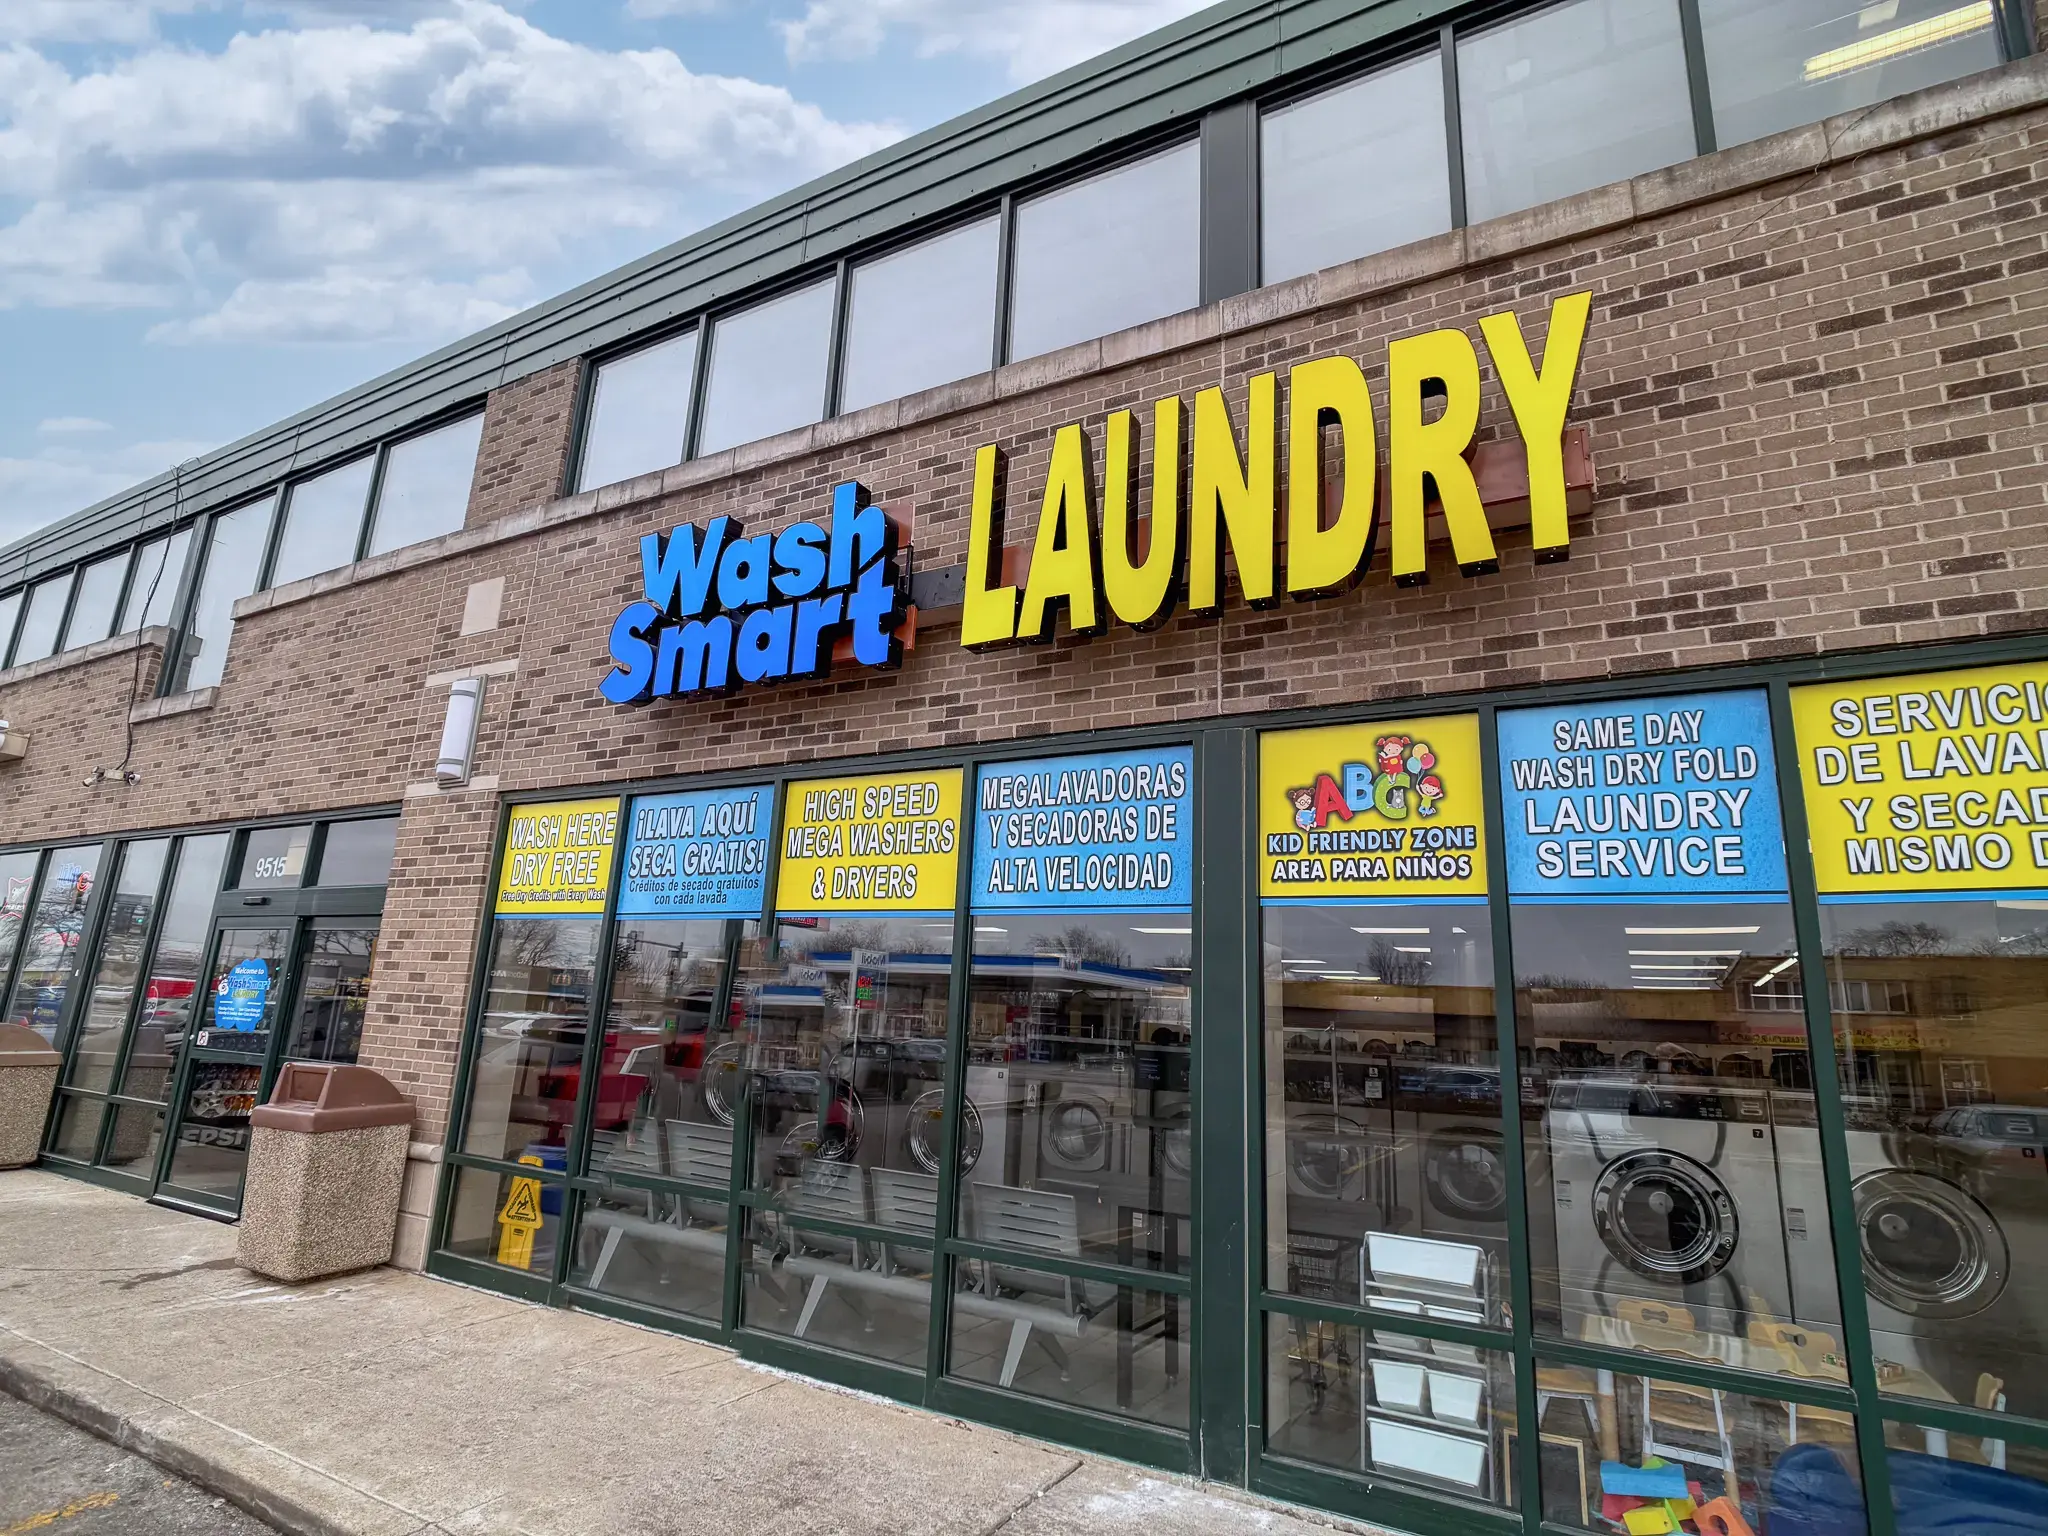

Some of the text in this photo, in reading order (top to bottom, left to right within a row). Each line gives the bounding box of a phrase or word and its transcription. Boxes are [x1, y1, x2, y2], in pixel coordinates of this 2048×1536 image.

[960, 290, 1593, 650] LAUNDRY
[639, 481, 889, 617] Wash
[598, 557, 894, 704] Smart
[1831, 681, 2048, 738] SERVICI
[1554, 710, 1704, 752] SAME DAY
[1512, 745, 1758, 790] WASH DRY FOLD
[1814, 743, 1883, 785] DE
[803, 782, 940, 823] HIGH SPEED
[981, 762, 1186, 810] MEGALAVADORAS
[1315, 764, 1411, 828] ABC
[511, 811, 617, 849] WASH HERE
[700, 792, 759, 838] AQUÍ
[989, 804, 1177, 848] Y SECADORAS DE
[1525, 788, 1752, 835] LAUNDRY
[1841, 798, 1872, 833] Y
[628, 838, 765, 879] SECA GRATIS!
[785, 818, 955, 861] MEGA WASHERS
[1267, 825, 1477, 856] KID FRIENDLY ZONE
[1537, 835, 1745, 878] SERVICE
[1845, 832, 2013, 875] MISMO
[255, 857, 288, 878] 9515
[510, 850, 600, 886] DRY FREE
[629, 877, 759, 894] Créditos de secado gratuitos
[810, 863, 918, 900] & DRYERS
[987, 852, 1172, 893] ALTA VELOCIDAD
[1271, 852, 1472, 882] AREA PARA NIÑOS
[501, 888, 606, 904] Free Dry Credits with Every Wash
[654, 891, 727, 905] con cada lavada
